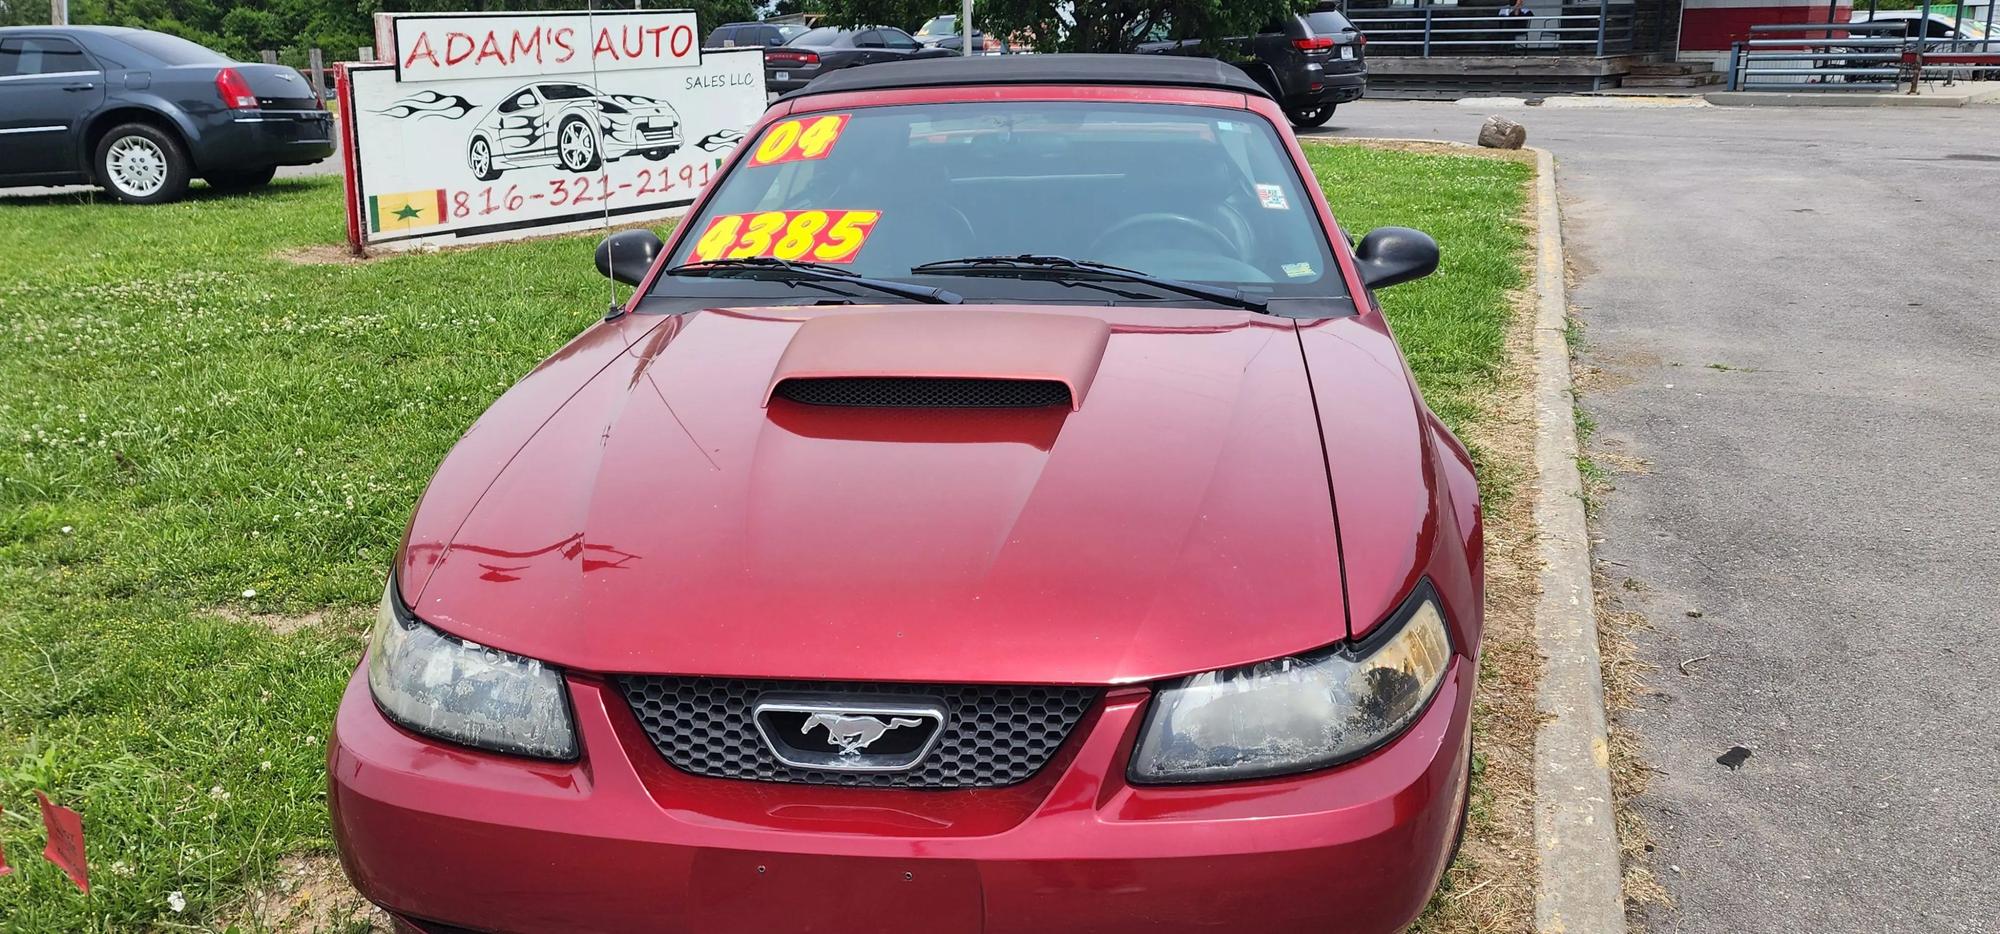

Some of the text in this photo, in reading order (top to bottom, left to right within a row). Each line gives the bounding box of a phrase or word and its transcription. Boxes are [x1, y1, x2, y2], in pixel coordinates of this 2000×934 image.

[404, 24, 693, 68] ADAM'S AUTO
[685, 72, 754, 90] SALES LLC
[755, 115, 842, 164] 04
[453, 161, 711, 218] 816-321-2191
[696, 210, 879, 262] 4385
